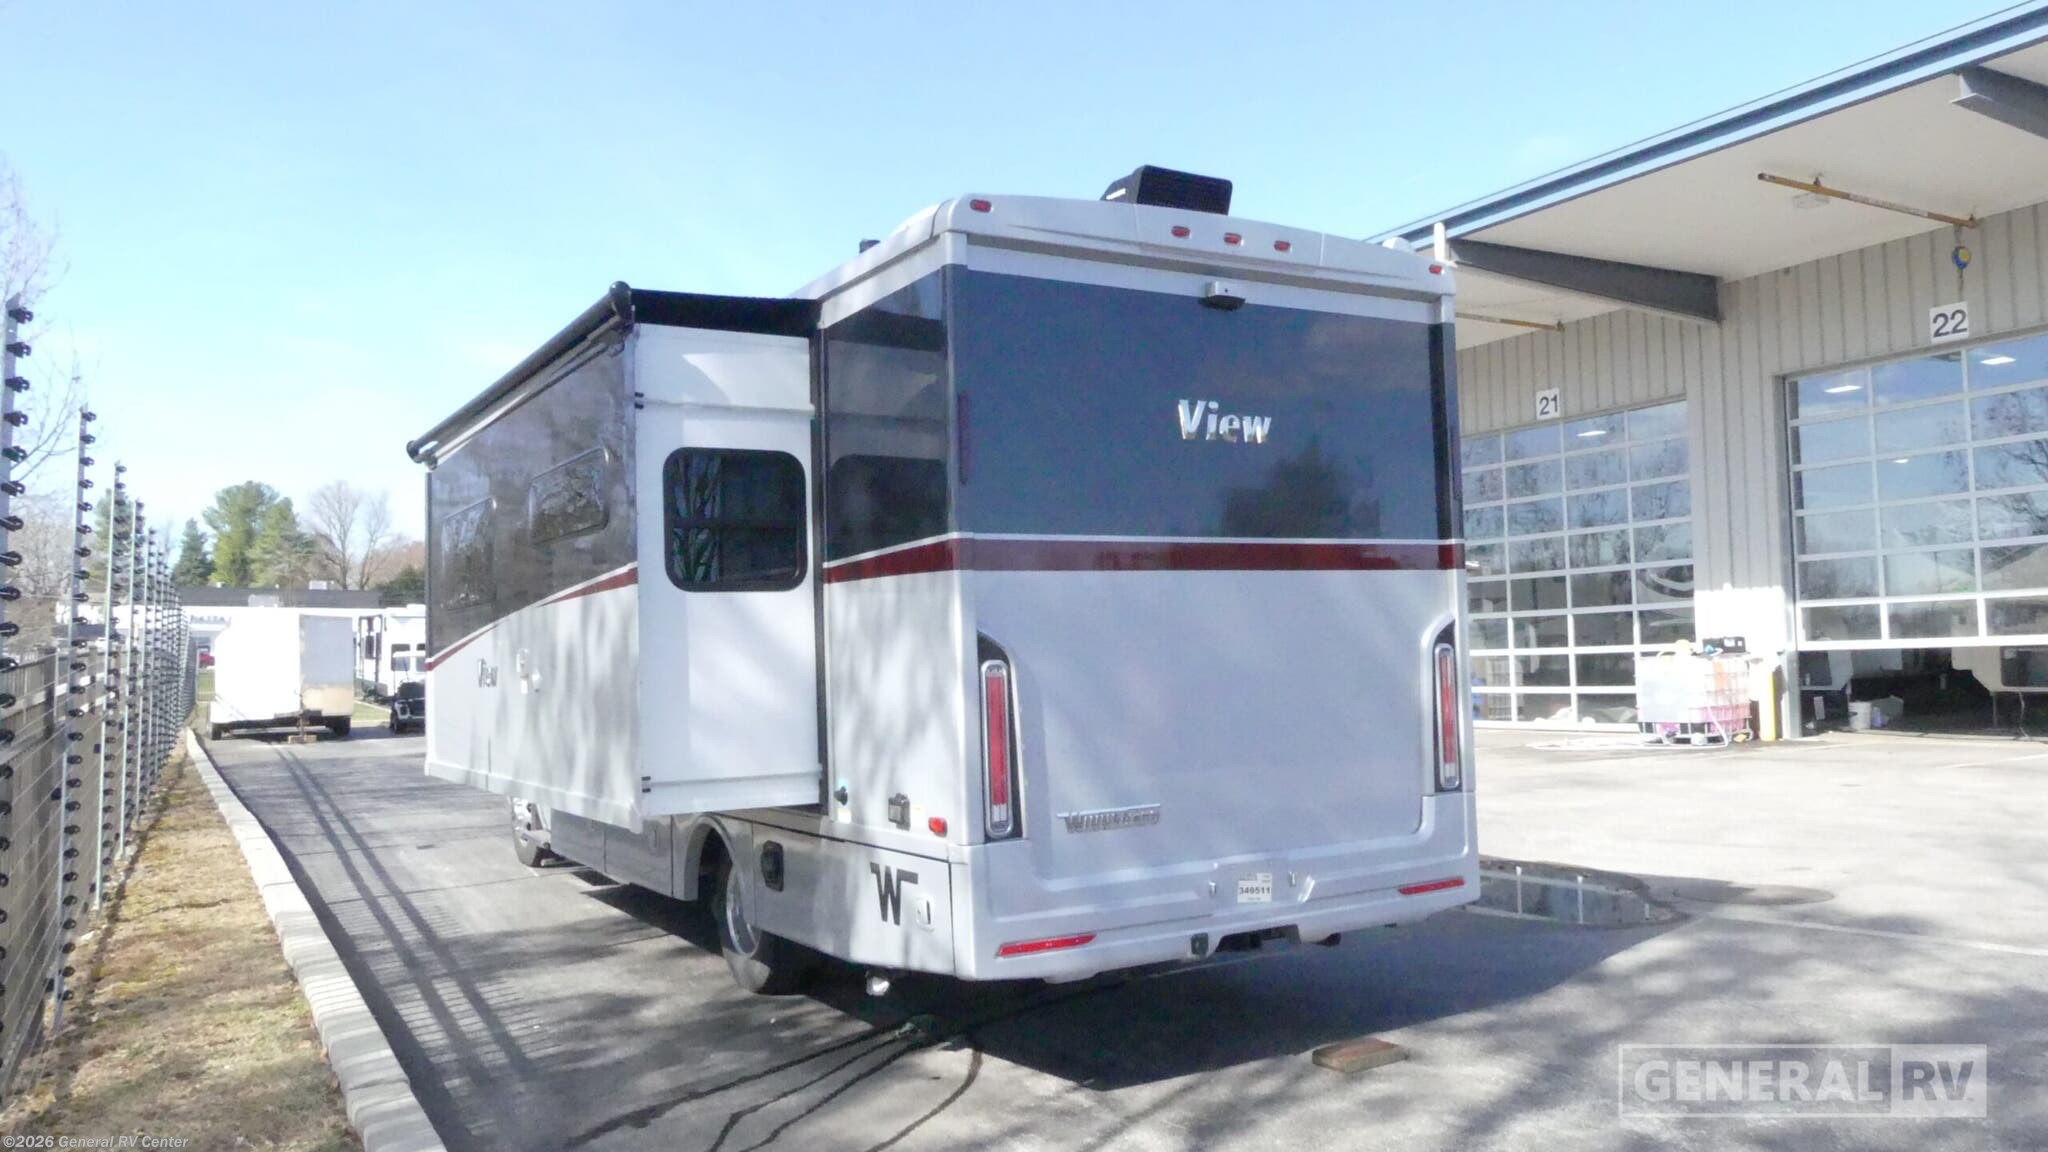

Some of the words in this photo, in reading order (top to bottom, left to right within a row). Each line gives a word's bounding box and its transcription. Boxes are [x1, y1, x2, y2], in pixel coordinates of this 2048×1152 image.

[1932, 309, 1968, 338] 22
[1539, 394, 1558, 416] 21
[1178, 399, 1272, 444] View
